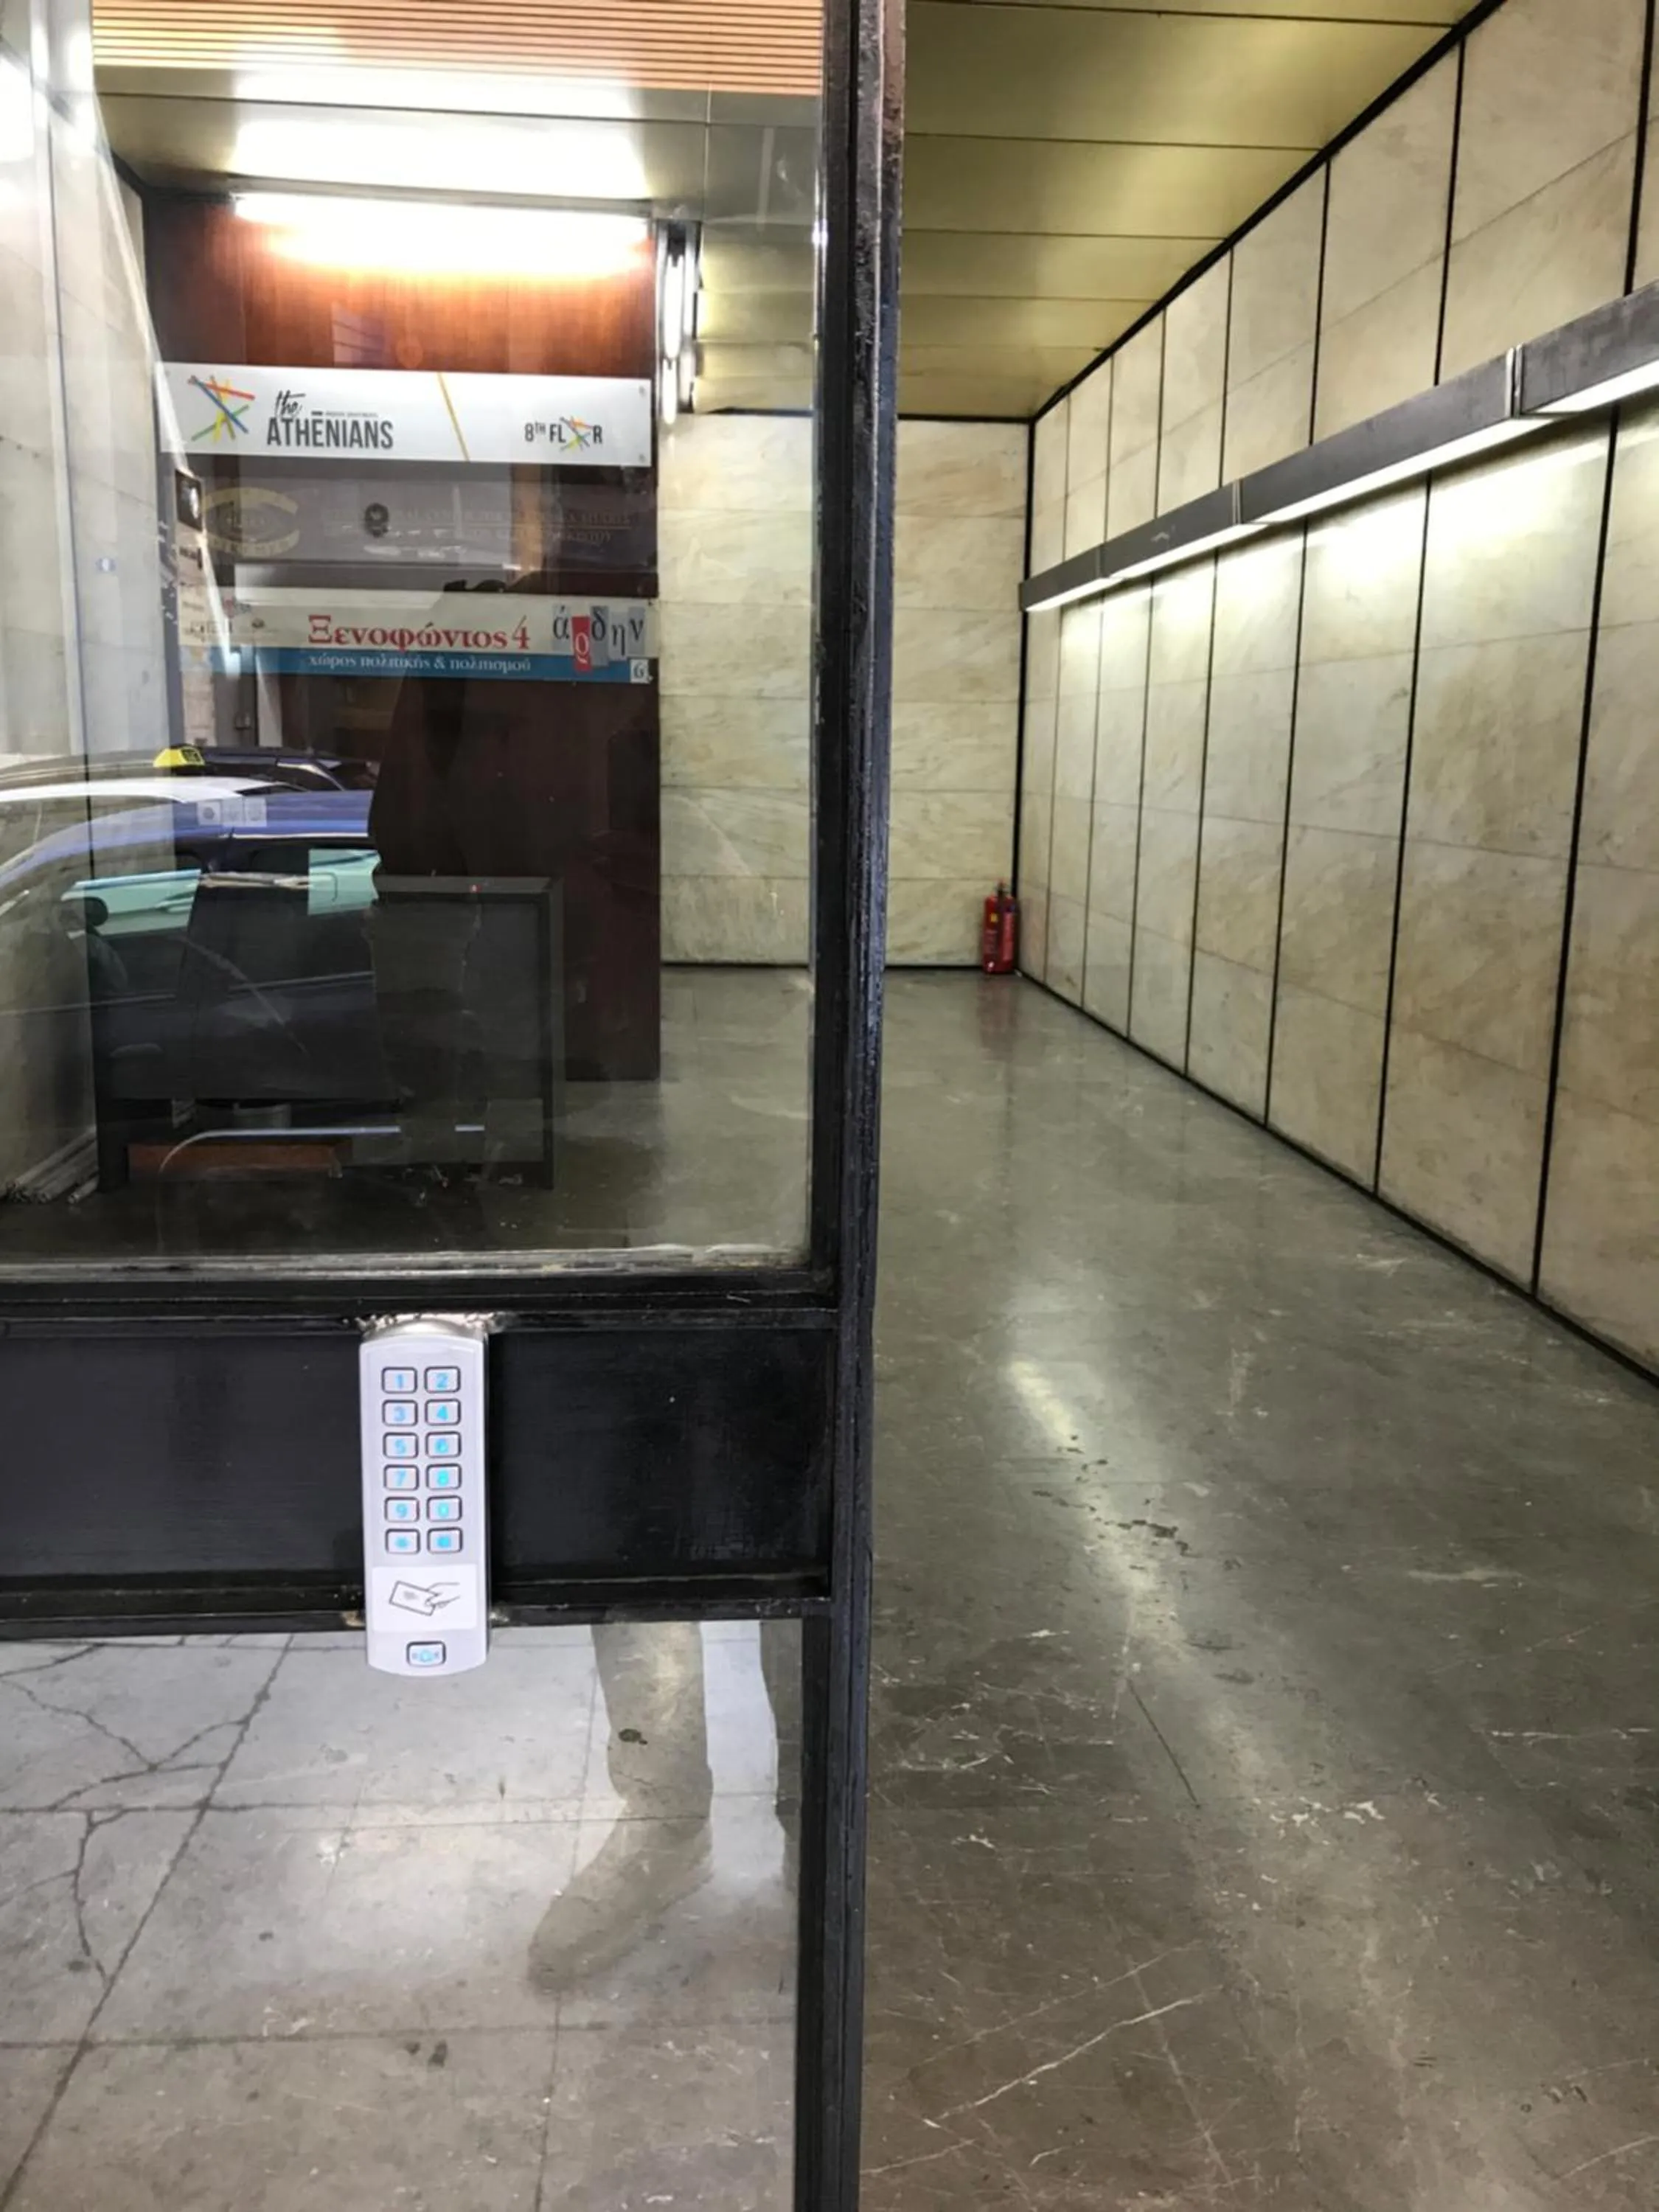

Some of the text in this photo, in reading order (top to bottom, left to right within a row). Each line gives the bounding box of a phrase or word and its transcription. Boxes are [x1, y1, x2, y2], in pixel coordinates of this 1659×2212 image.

[307, 614, 530, 653] Ξενοφώντος 4
[308, 652, 531, 674] χώρος πολιτικής & πολιτισμού
[436, 1371, 449, 1389] 2
[393, 1403, 449, 1422] 3 4
[394, 1438, 406, 1455] 5
[394, 1470, 407, 1488] 7
[395, 1502, 408, 1519] 9
